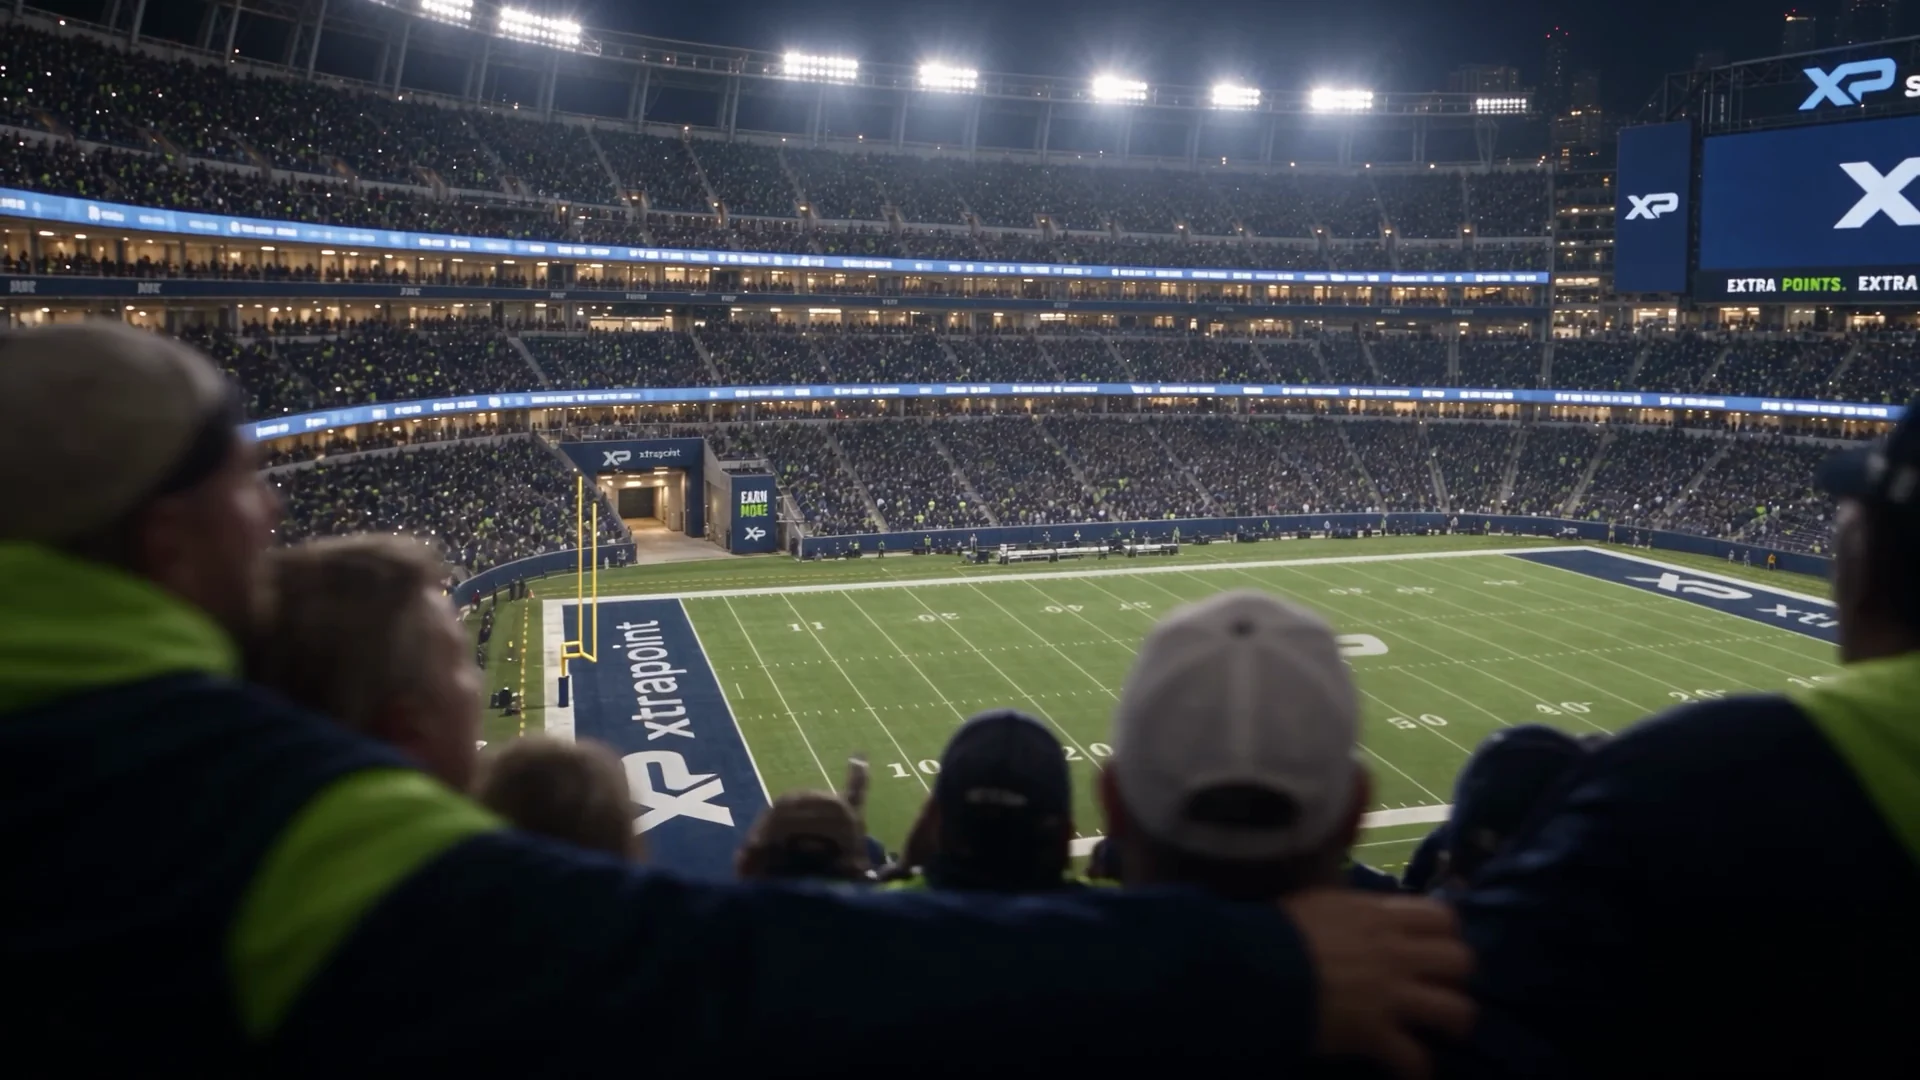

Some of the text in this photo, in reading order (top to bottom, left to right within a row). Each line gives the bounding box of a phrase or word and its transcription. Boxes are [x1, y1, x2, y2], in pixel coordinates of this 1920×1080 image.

[1799, 58, 1896, 110] XP
[1625, 193, 1679, 220] XP
[1833, 157, 1920, 229] X
[1727, 275, 1918, 293] EXTRA POINTS. EXTRA
[602, 450, 632, 466] XP
[744, 527, 766, 541] XP
[1624, 572, 1753, 599] XP
[612, 620, 696, 741] xtrapoint
[1063, 742, 1115, 762] 20
[887, 759, 942, 778] 10
[620, 750, 735, 836] XP
